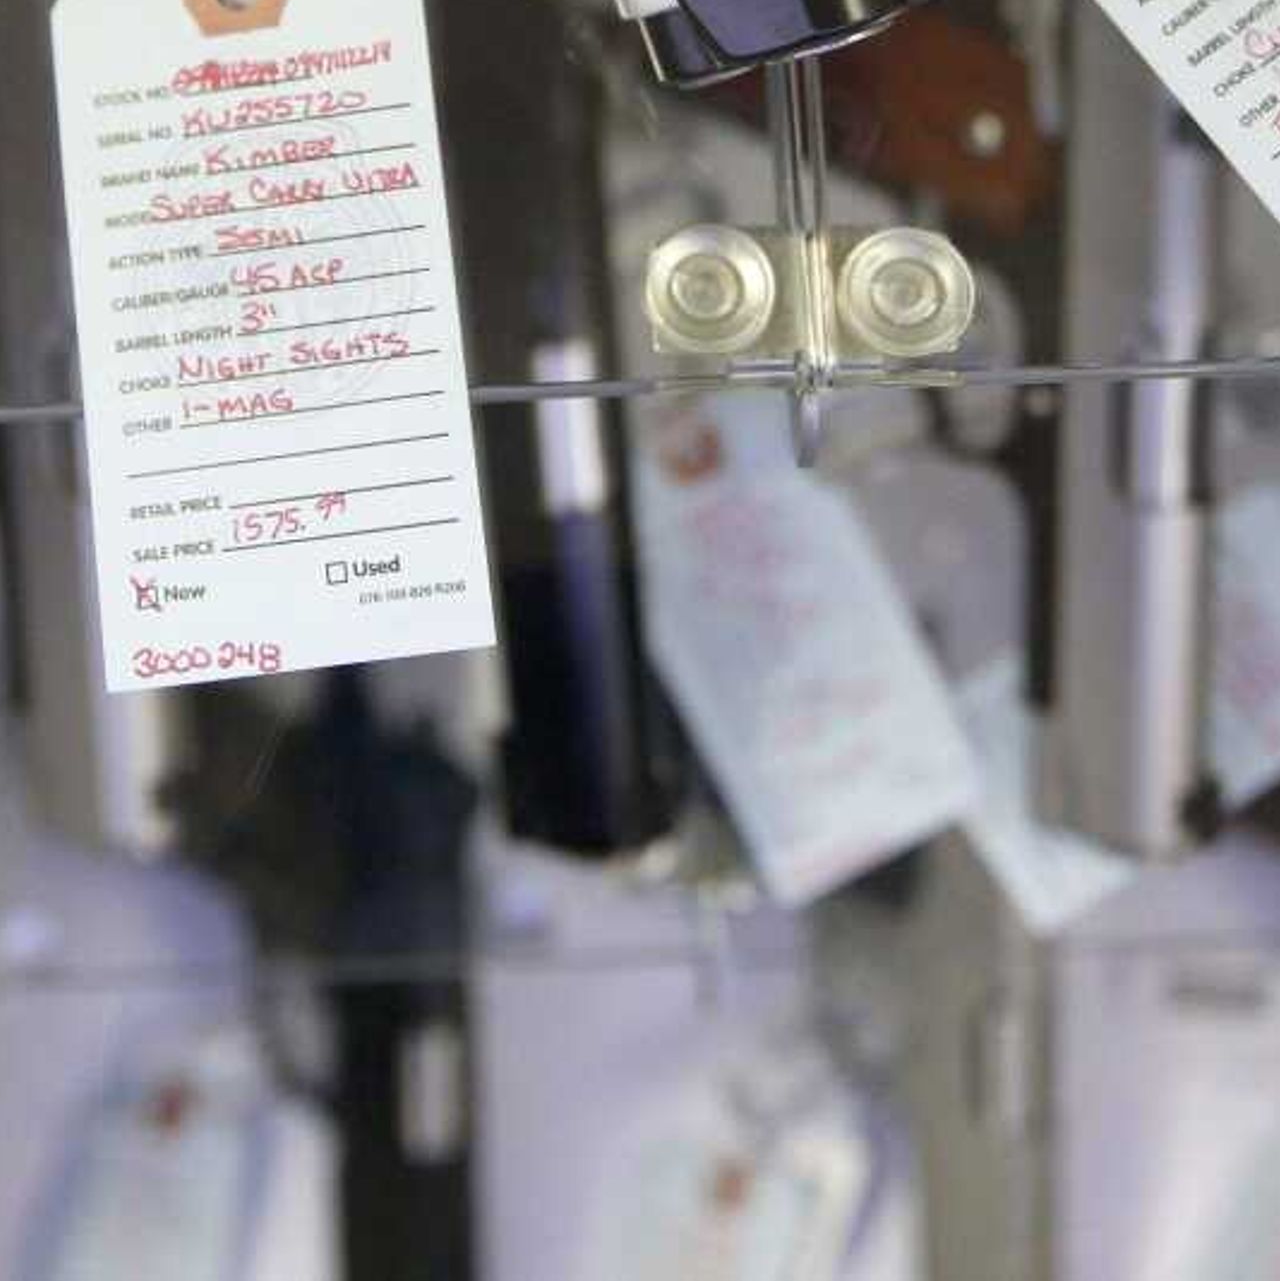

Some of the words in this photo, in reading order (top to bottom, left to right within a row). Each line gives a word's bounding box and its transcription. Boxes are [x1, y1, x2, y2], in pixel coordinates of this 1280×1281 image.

[1213, 63, 1254, 97] CHOKE
[1239, 95, 1278, 127] OTHER
[108, 251, 166, 270] ACTION
[169, 245, 203, 262] TYPE
[230, 261, 280, 294] 45
[289, 257, 345, 294] ACP
[114, 334, 169, 353] BARREL
[173, 326, 234, 348] LENGTH
[118, 376, 171, 396] CHOKE
[122, 418, 174, 437] OTHER
[130, 499, 177, 520] RETAIL
[180, 495, 221, 513] PRICE
[132, 545, 168, 563] SALE
[171, 540, 215, 560] PRICE
[163, 584, 207, 604] New
[351, 555, 401, 578] Used
